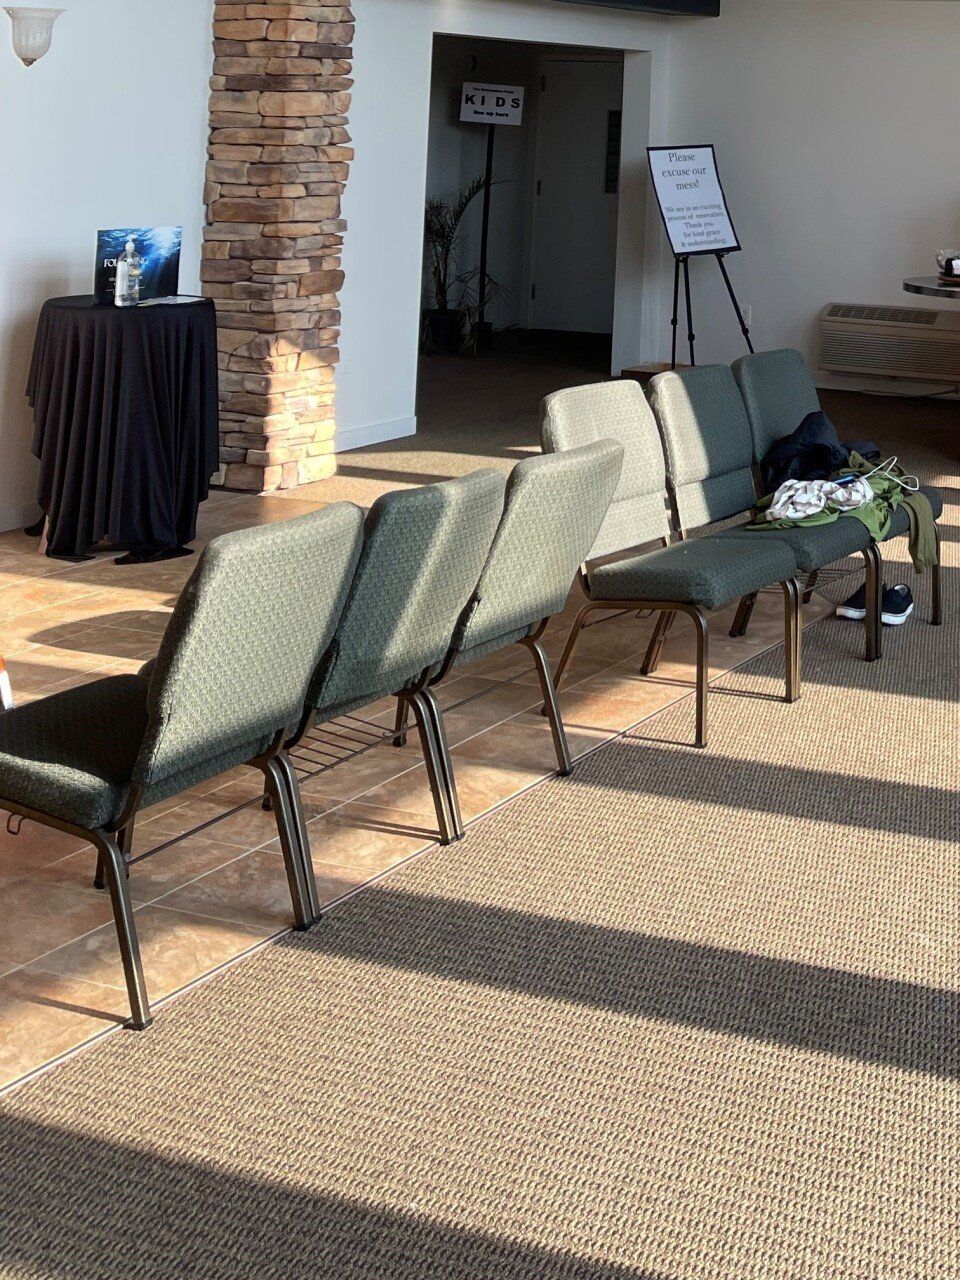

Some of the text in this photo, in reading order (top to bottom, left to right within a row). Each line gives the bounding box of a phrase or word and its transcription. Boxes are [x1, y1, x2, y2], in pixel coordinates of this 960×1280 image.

[465, 93, 520, 109] KIDS
[668, 152, 696, 162] Please
[661, 167, 706, 178] excuse our
[675, 178, 700, 190] mess!
[683, 220, 703, 229] Thank
